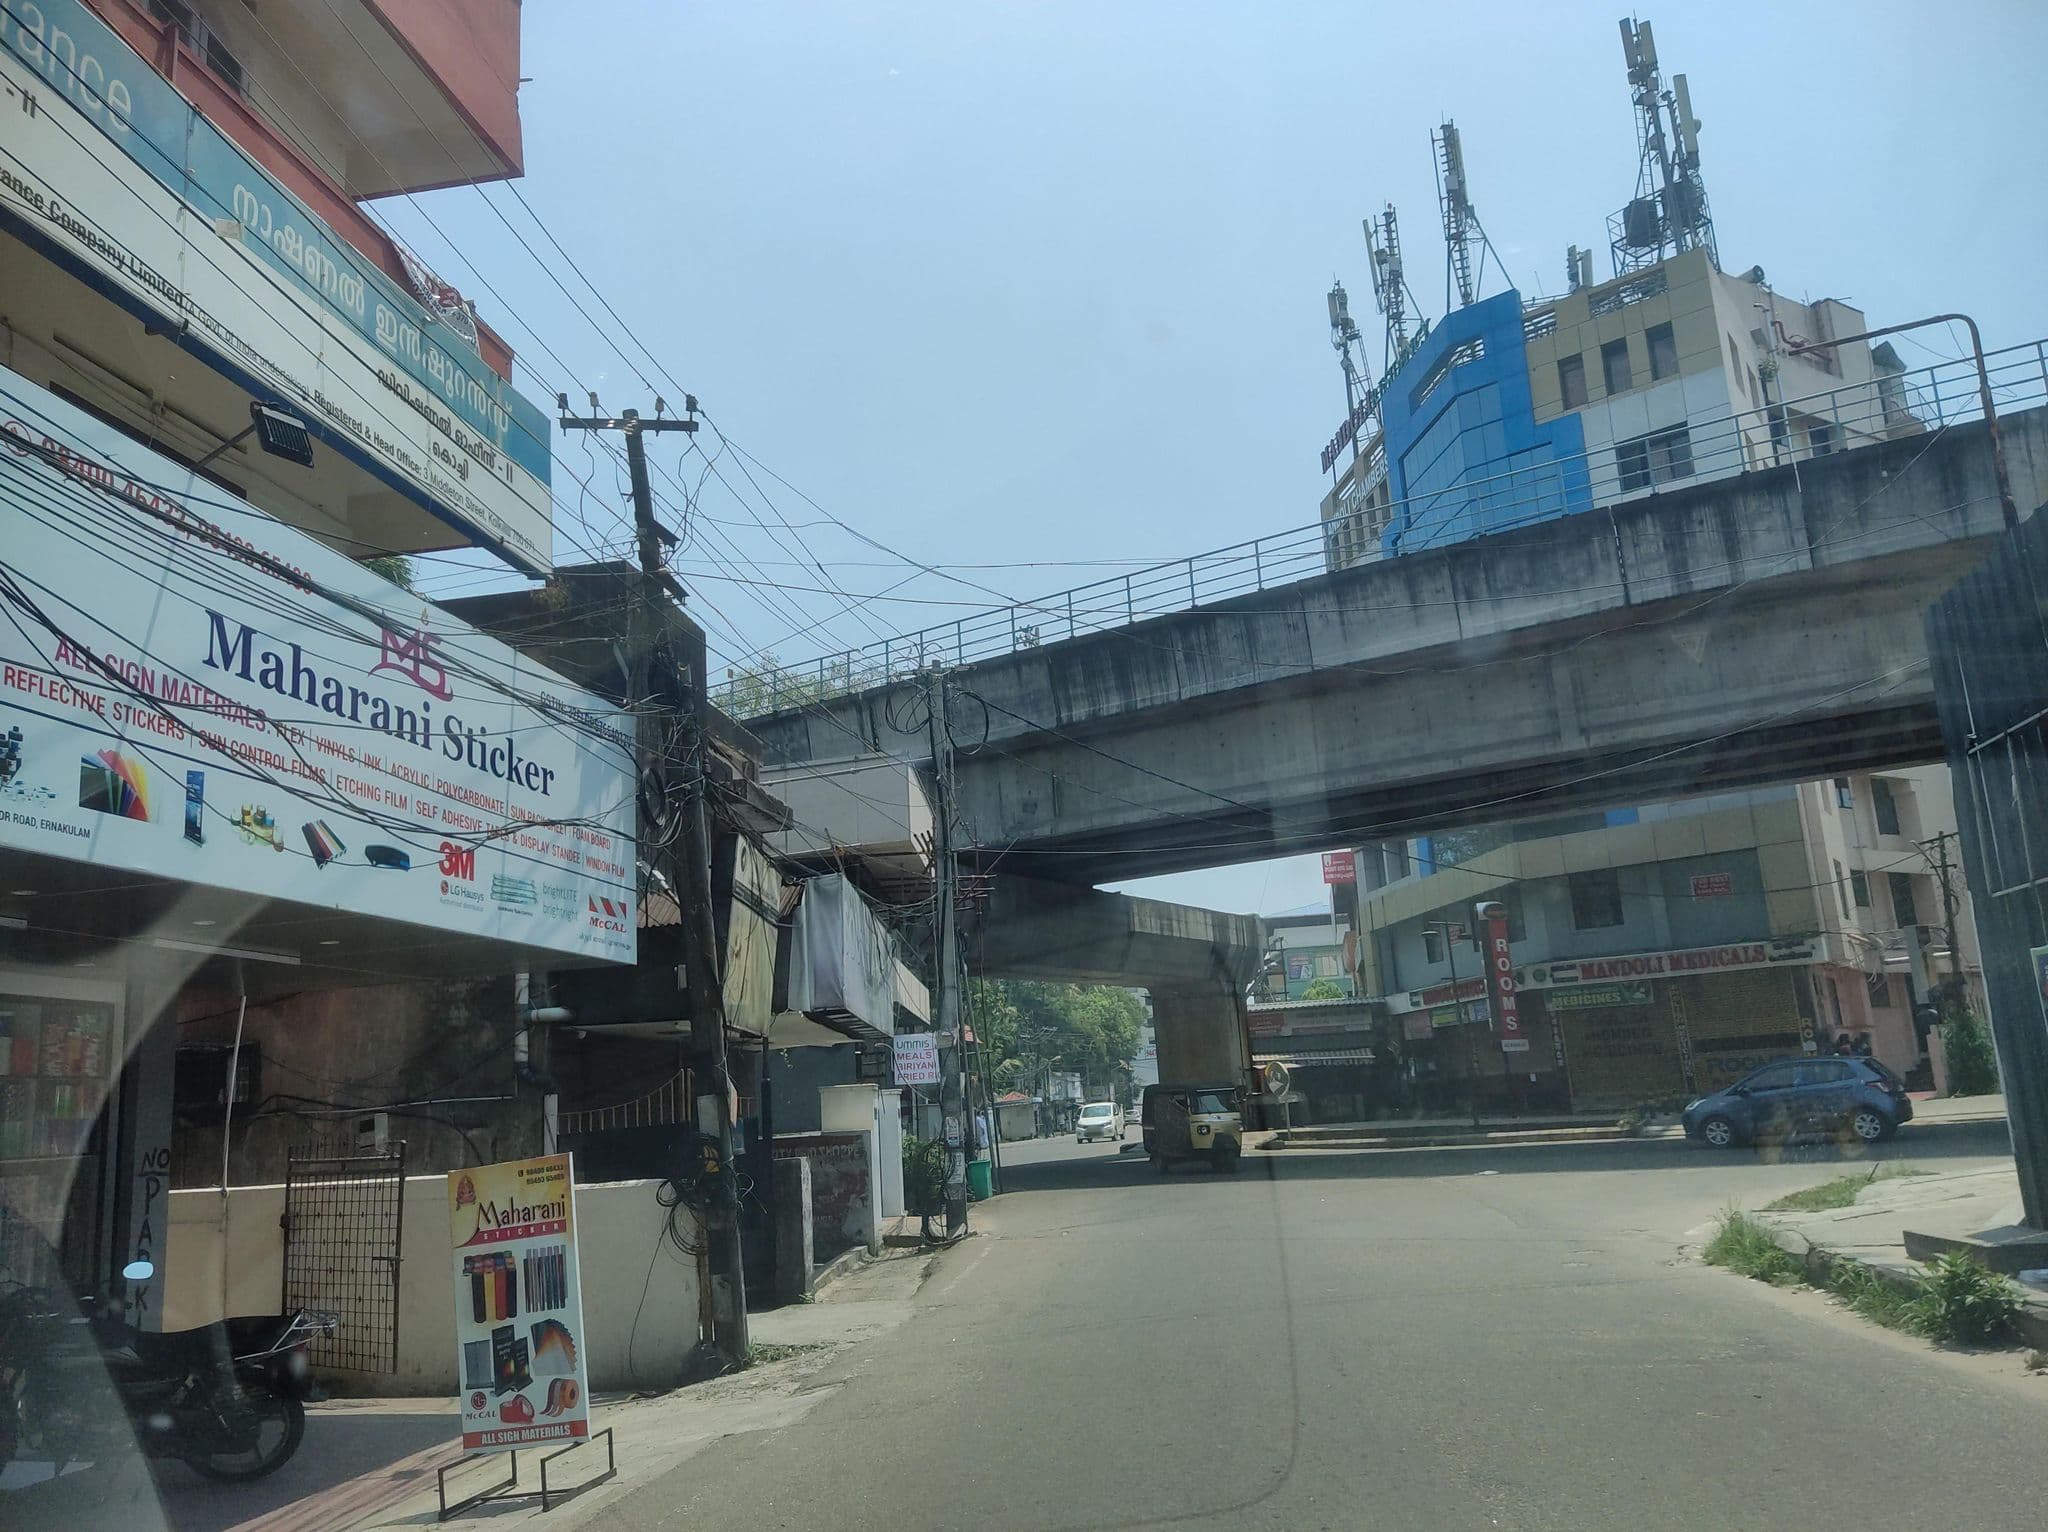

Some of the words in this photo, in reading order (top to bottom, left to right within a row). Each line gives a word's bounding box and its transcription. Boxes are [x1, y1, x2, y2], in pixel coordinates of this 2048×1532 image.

[50, 199, 126, 272] Company
[129, 255, 184, 307] Limited
[314, 390, 363, 434] Registered
[364, 425, 372, 441] &
[373, 431, 395, 457] Head
[396, 447, 422, 475] Office:
[423, 467, 429, 480] 3
[429, 470, 465, 505] Middleton
[432, 441, 469, 482] കൊച്ചി
[202, 607, 434, 751] Maharani
[442, 714, 555, 797] Sticker
[55, 637, 98, 675] ALL
[104, 653, 156, 695] SIGN
[276, 721, 306, 747] FLEX
[315, 734, 356, 764] VINYLS
[363, 751, 382, 773] INK
[391, 762, 430, 789] ACRYLIC
[436, 778, 506, 815] POLYCARBONATE
[510, 804, 526, 820] SUN
[572, 825, 590, 844] FOAM
[590, 831, 611, 851] BOARD
[4, 664, 106, 718] REFLECTIVE
[112, 701, 186, 742] STICKERS
[198, 729, 227, 753] SUN
[230, 739, 289, 773] CONTROL
[291, 758, 326, 785] FILMS
[336, 774, 382, 803] ETCHING
[384, 789, 408, 811] FILM
[415, 800, 439, 820] SELF
[441, 808, 483, 833] ADHESIVE
[511, 833, 518, 844] &
[520, 834, 550, 855] DISPLAY
[551, 844, 581, 865] STANDEE
[585, 855, 611, 875] WINDOW
[611, 862, 625, 878] FILM
[12, 813, 39, 830] ROAD,
[40, 818, 91, 839] ERNAKULAM
[438, 841, 475, 882] 3M
[450, 884, 460, 896] LG
[589, 916, 627, 933] McCAL
[1579, 956, 1665, 980] MANDOLI
[1668, 944, 1767, 972] MEDICALS
[1494, 938, 1518, 1031] ROOMS
[896, 1051, 933, 1061] MEALS
[897, 1072, 925, 1081] FRIED
[140, 1149, 170, 1175] NO
[478, 1194, 566, 1228] Maharani
[483, 1222, 559, 1240] STICKER
[465, 1410, 497, 1420] McCAL
[481, 1431, 497, 1444] ALL
[498, 1429, 520, 1444] SIGN
[521, 1424, 571, 1440] MATERIALS
